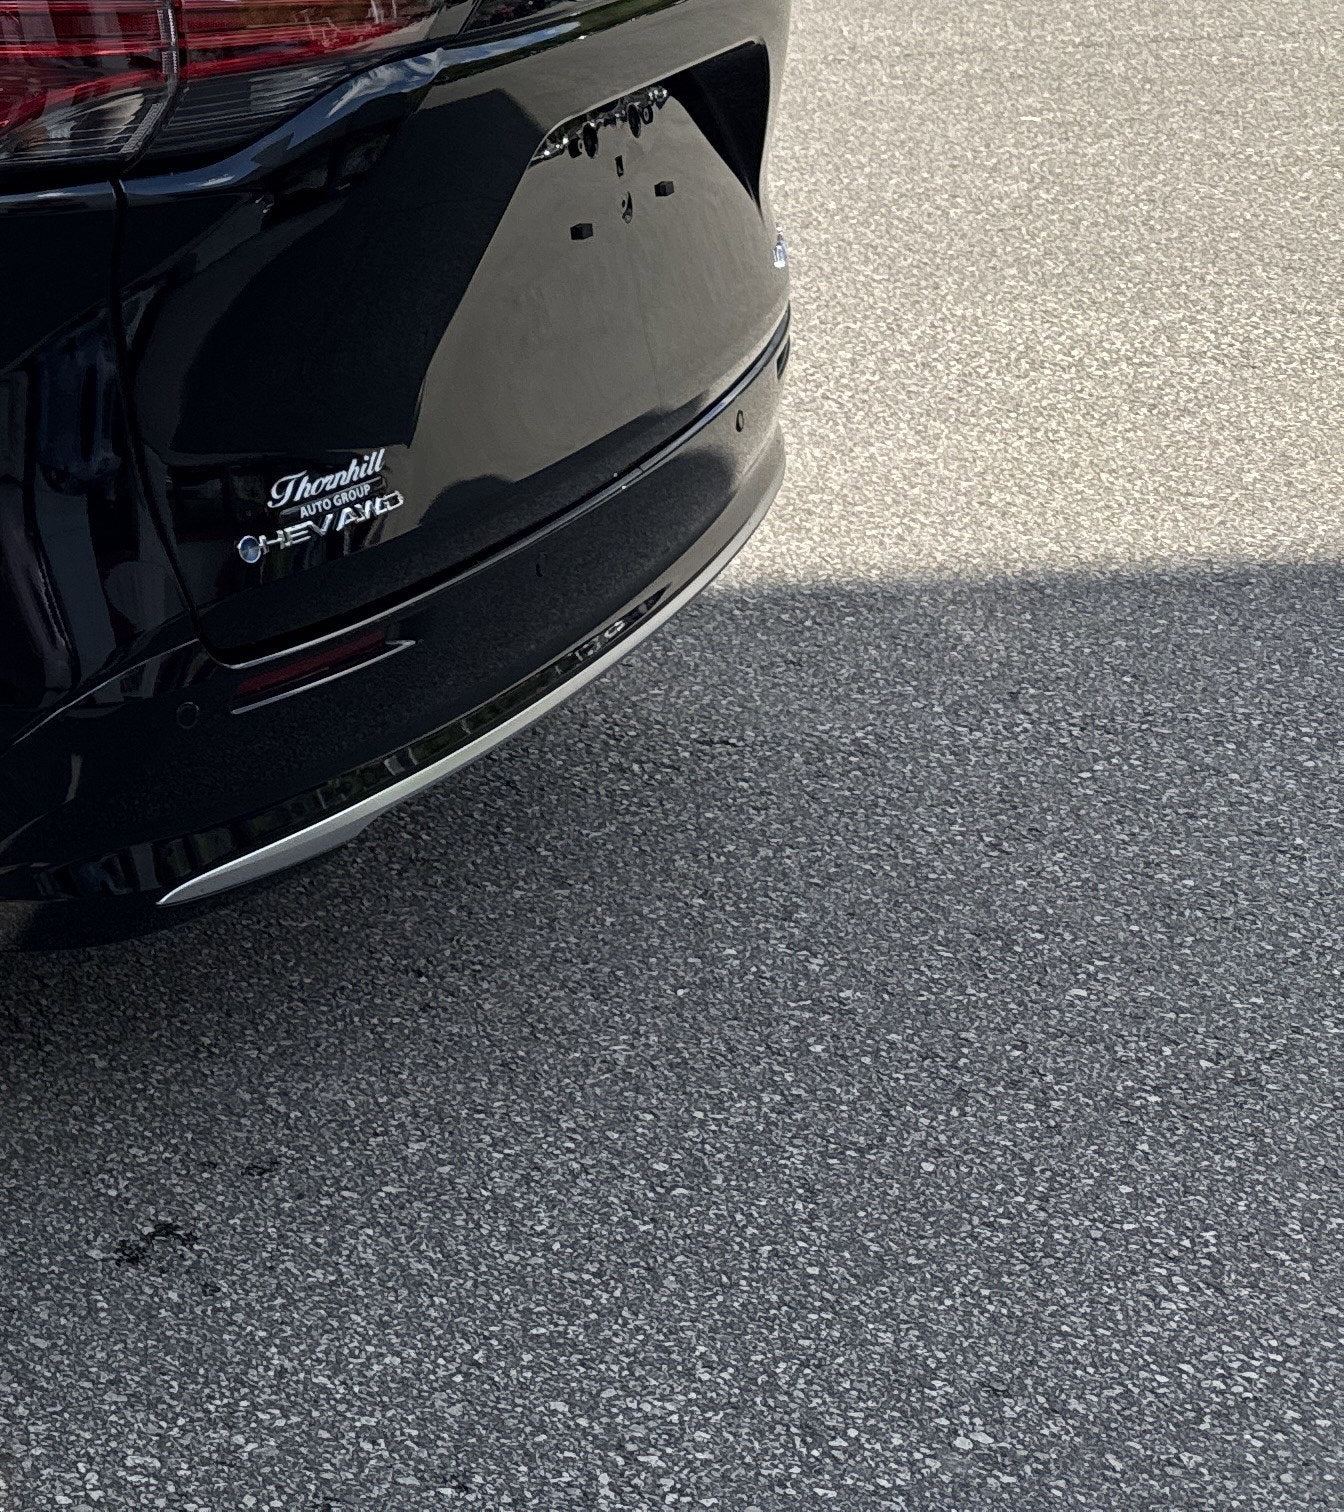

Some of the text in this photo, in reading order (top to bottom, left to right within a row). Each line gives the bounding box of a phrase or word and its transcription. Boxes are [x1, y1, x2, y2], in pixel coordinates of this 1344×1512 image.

[267, 448, 386, 509] Thornhill
[300, 483, 371, 519] AUTO GROUP
[259, 490, 404, 554] HEV AWD
